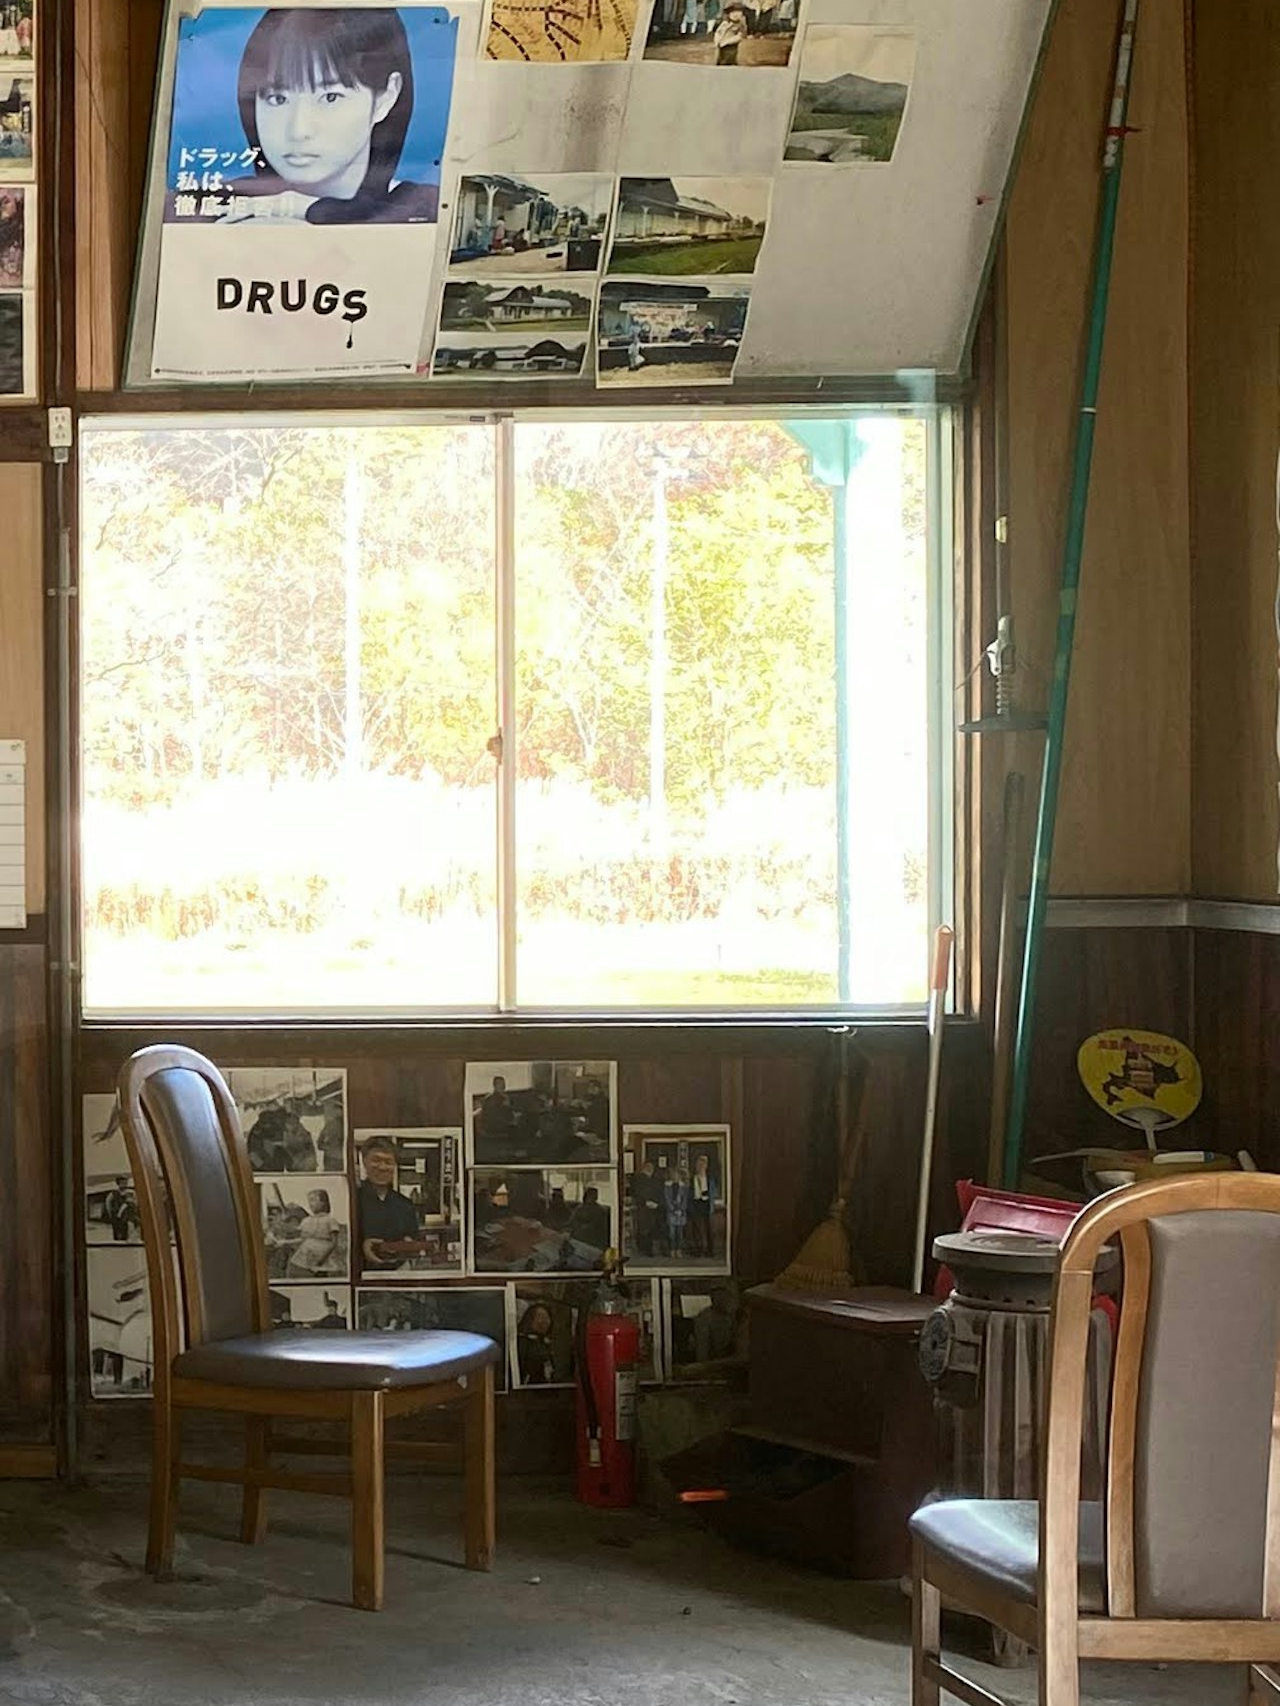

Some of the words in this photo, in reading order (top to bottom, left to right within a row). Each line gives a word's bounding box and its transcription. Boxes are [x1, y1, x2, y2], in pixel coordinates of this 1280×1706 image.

[179, 148, 267, 169] ドラッグ、
[176, 171, 234, 192] 私は、
[217, 278, 368, 322] DRUGS
